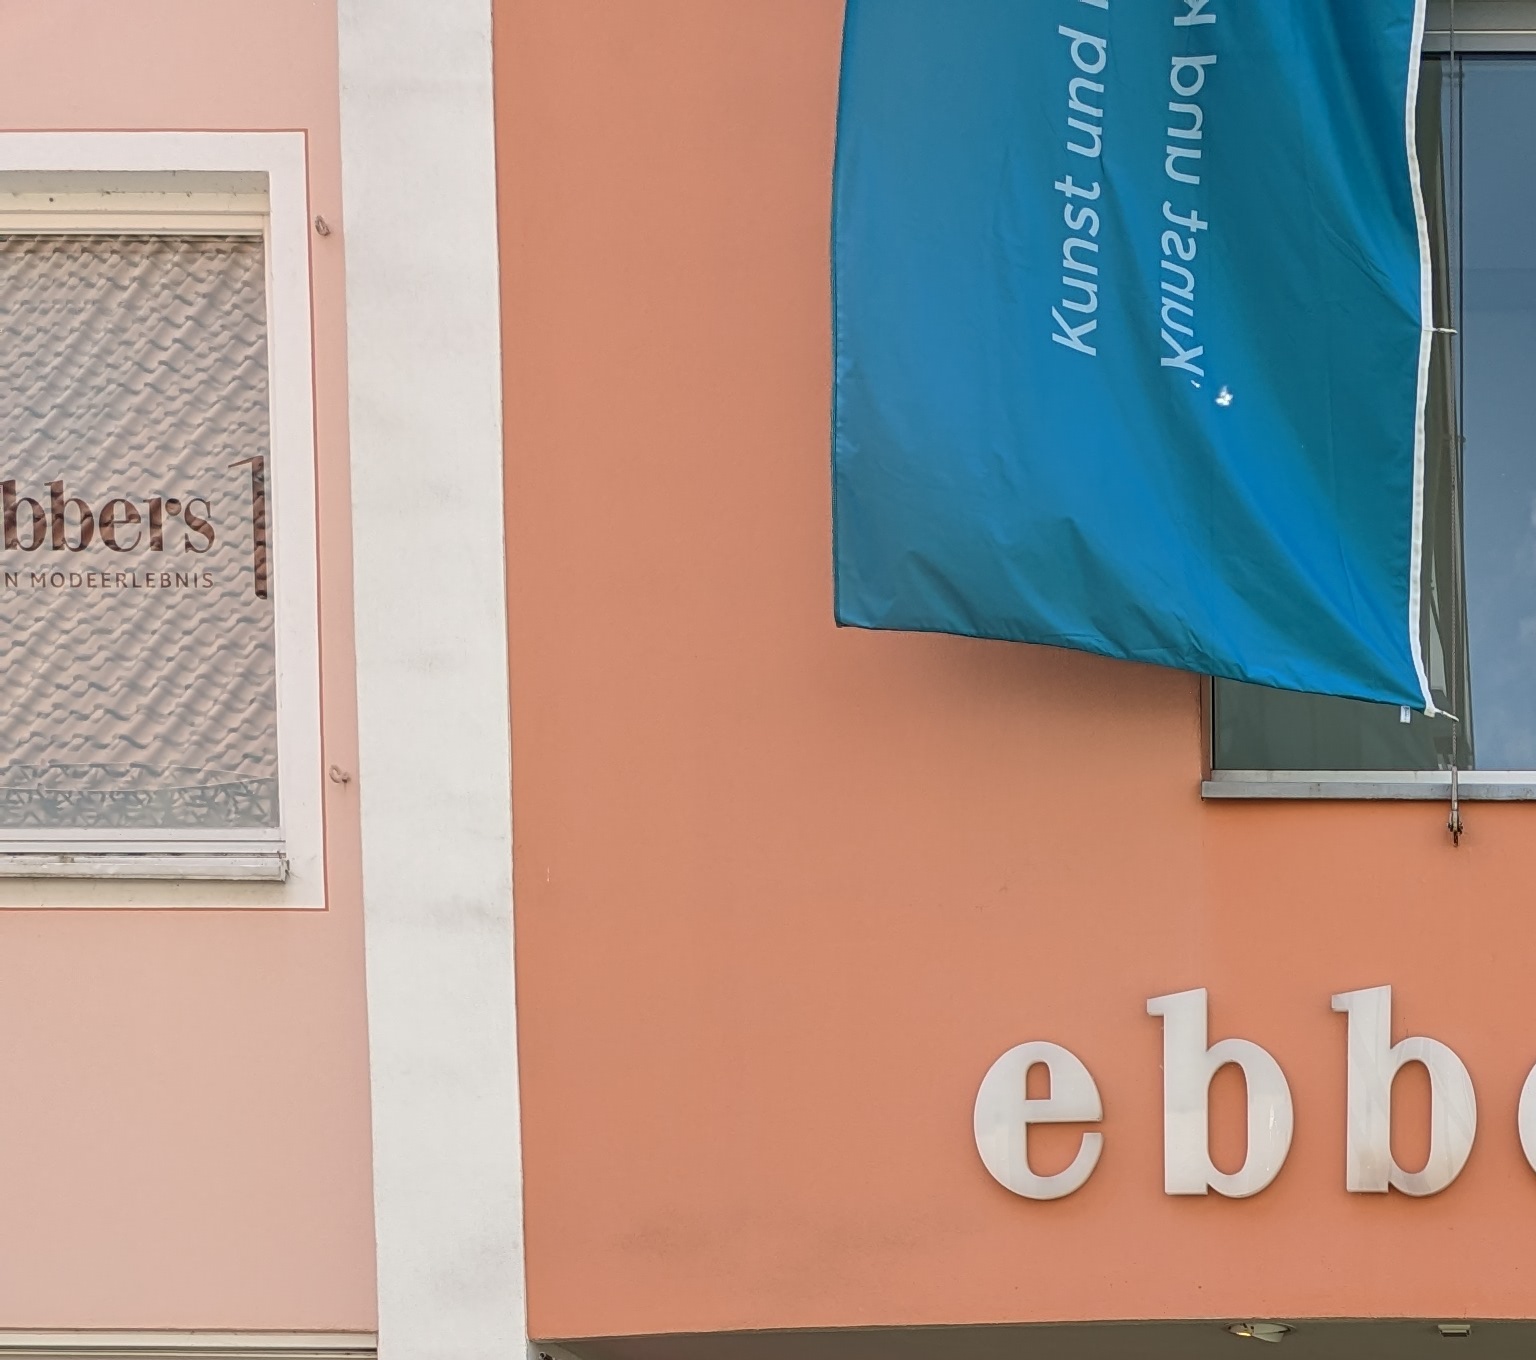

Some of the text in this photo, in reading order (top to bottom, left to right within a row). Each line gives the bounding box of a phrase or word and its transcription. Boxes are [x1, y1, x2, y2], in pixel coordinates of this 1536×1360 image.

[1057, 24, 1108, 160] und
[1052, 174, 1101, 357] Kunst
[30, 571, 214, 589] MODEERLEBNIS
